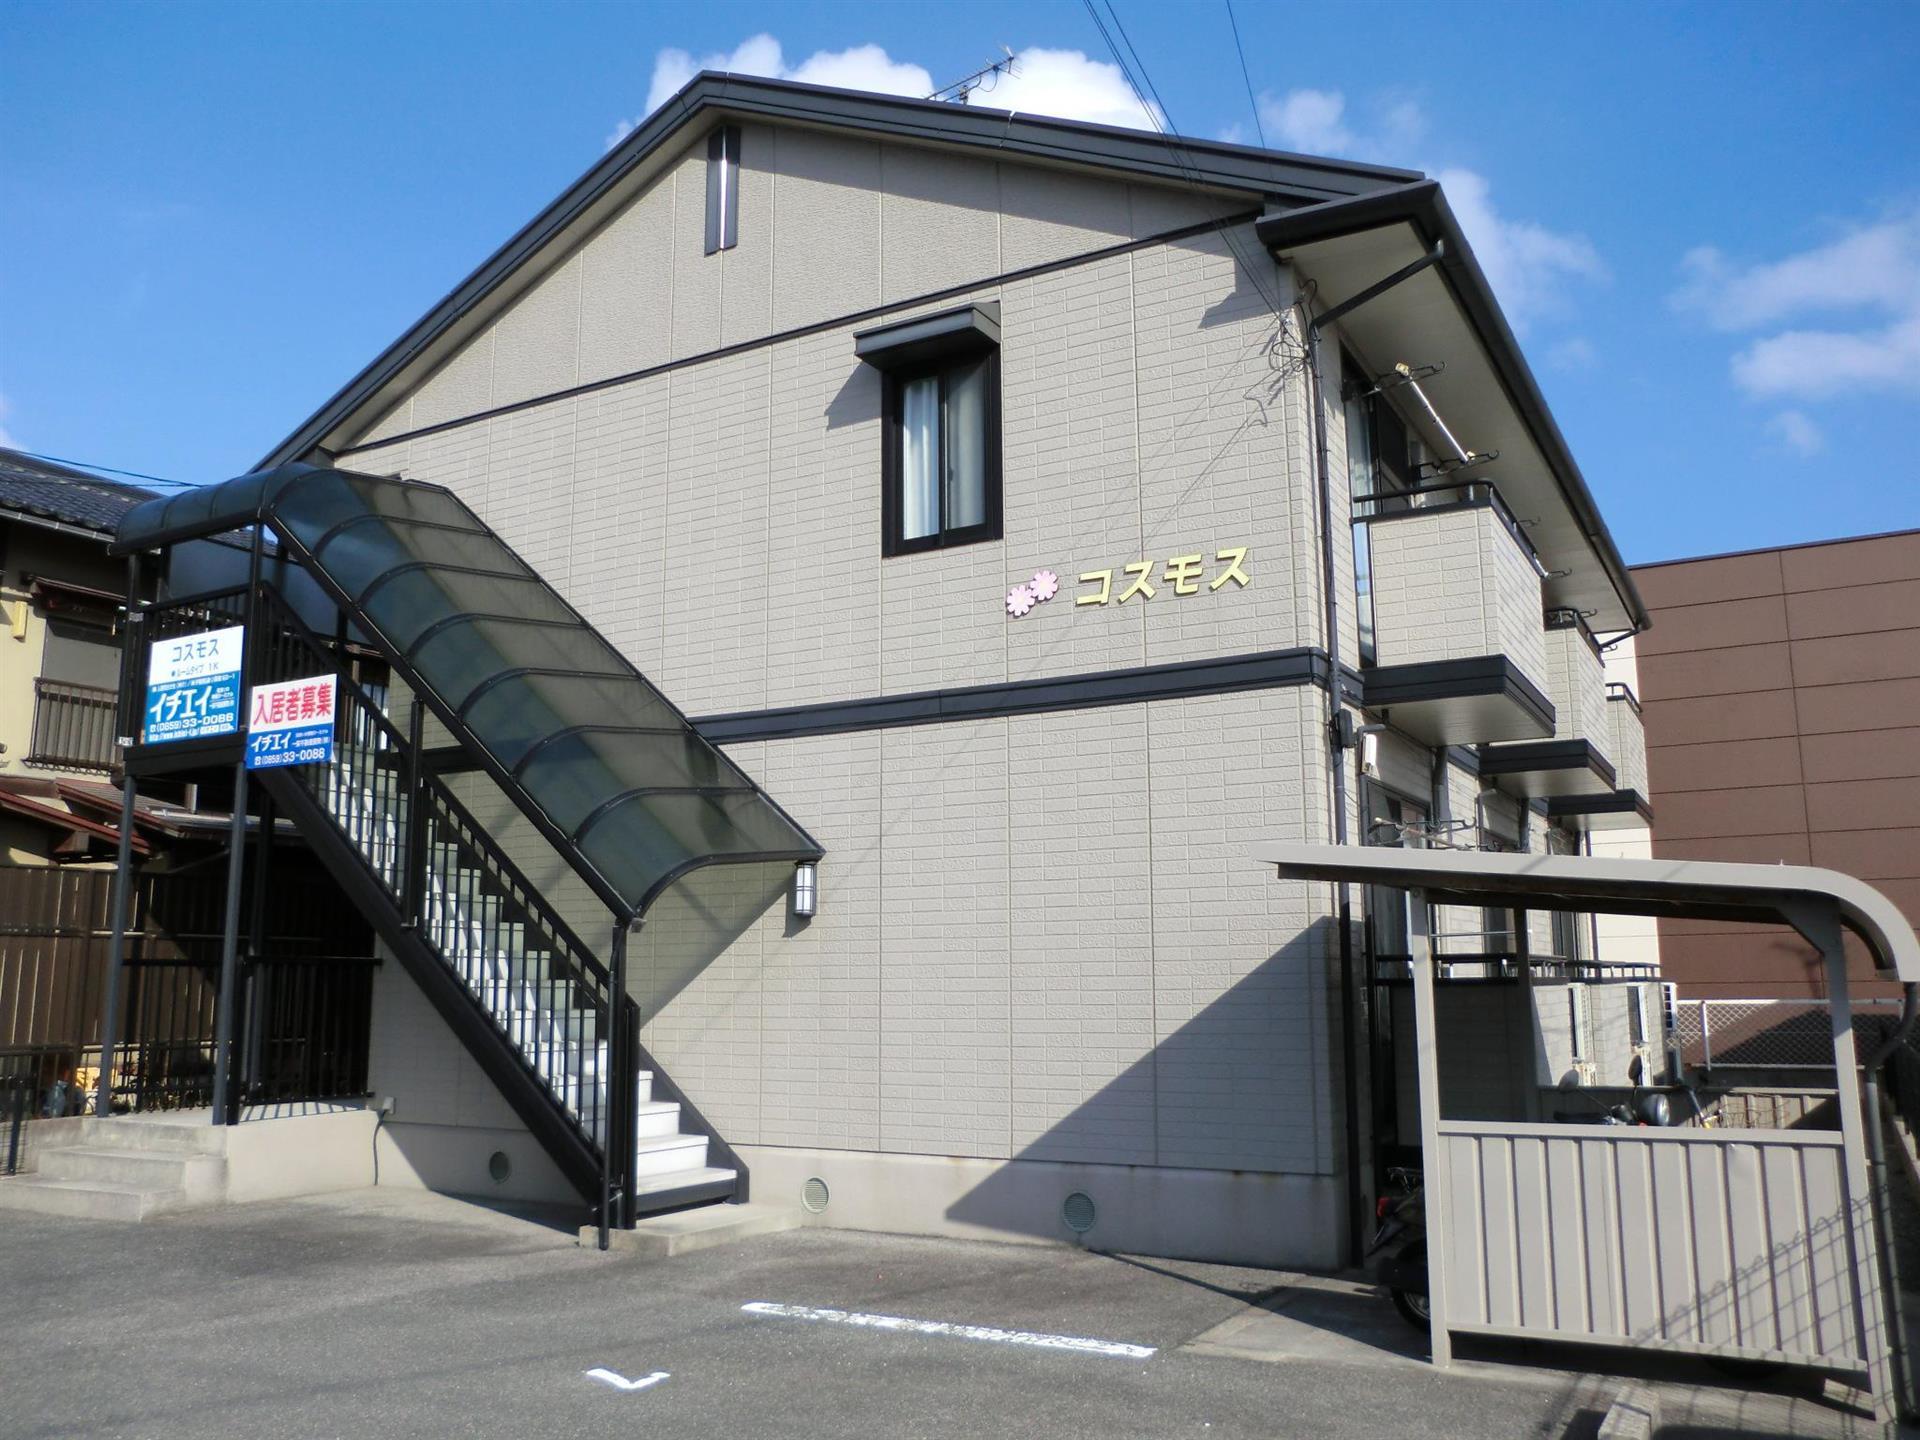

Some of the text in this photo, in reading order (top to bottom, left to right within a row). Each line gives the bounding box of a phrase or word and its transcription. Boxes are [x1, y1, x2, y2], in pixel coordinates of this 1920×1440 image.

[1075, 547, 1250, 607] コスモス
[172, 638, 219, 662] コスモス
[150, 686, 212, 722] イチエイ
[253, 683, 332, 725] 入居者募集
[251, 732, 292, 753] イチエイ
